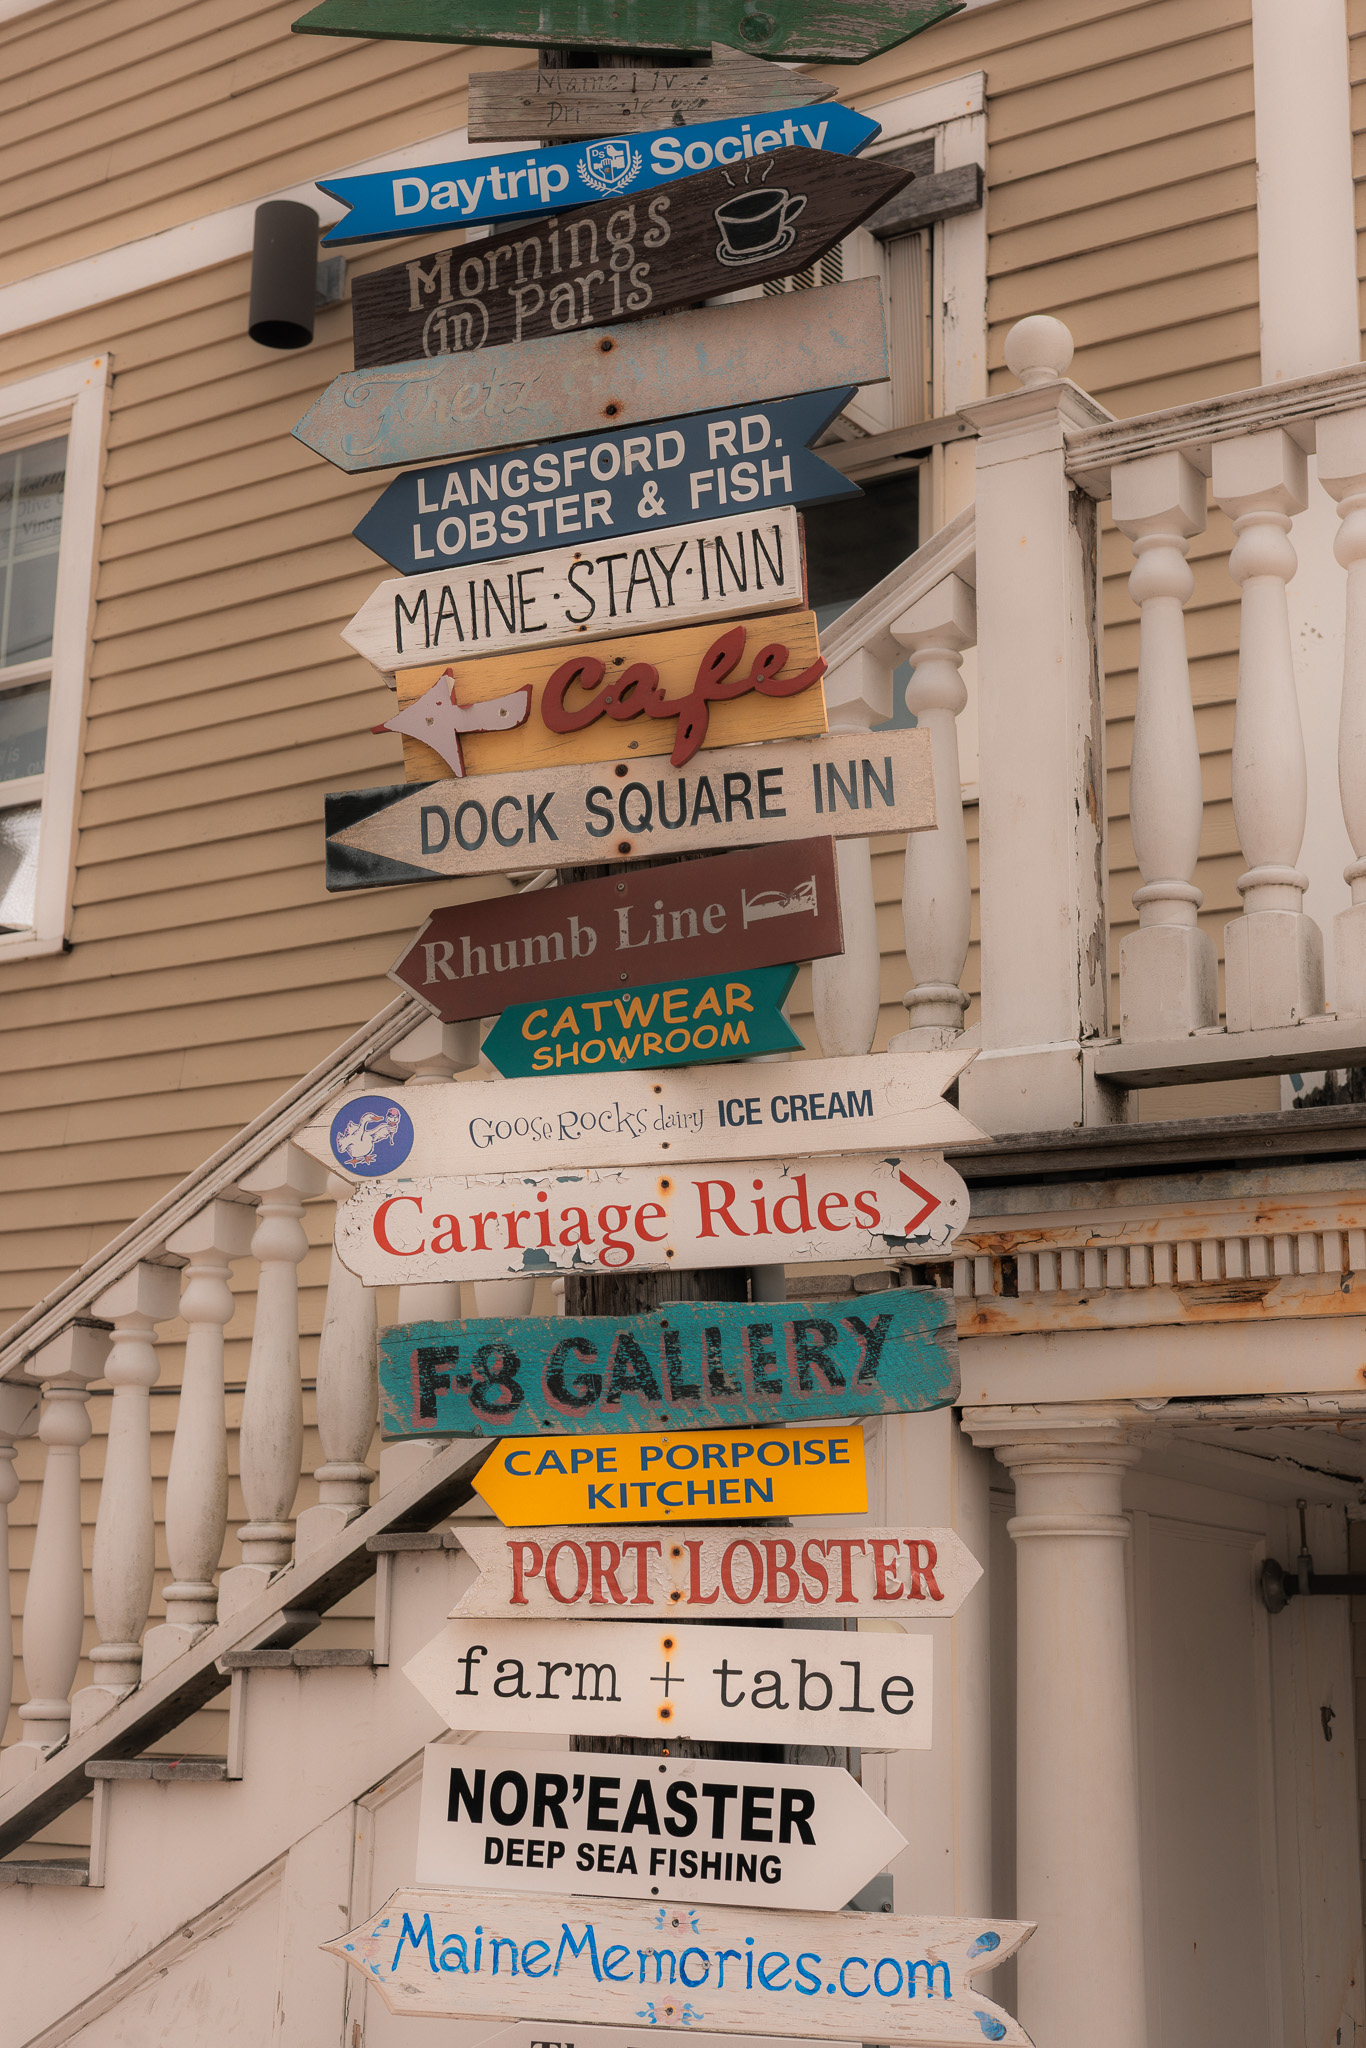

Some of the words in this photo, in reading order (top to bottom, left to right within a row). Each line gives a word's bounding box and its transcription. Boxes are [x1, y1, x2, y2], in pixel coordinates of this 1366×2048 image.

[392, 158, 569, 217] Daytrip
[651, 119, 828, 175] Society
[406, 196, 671, 312] Mornings
[508, 262, 653, 343] Paris
[417, 429, 686, 513] LANGSFORD
[708, 414, 783, 459] RD.
[413, 489, 614, 559] LOBSTER
[636, 479, 667, 519] &
[689, 454, 793, 508] FISH
[541, 625, 828, 768] Cafe
[421, 793, 559, 855] DOCK
[585, 767, 787, 838] SQUARE
[812, 756, 895, 814] INN
[421, 916, 597, 986] Rhumb
[613, 895, 728, 952] Line
[521, 982, 755, 1042] CATWEAR
[531, 1021, 751, 1070] SHOWROOM
[653, 1104, 705, 1133] dairy
[718, 1097, 762, 1128] ICE
[770, 1090, 874, 1123] CREAM
[372, 1191, 668, 1268] Carriage
[691, 1172, 882, 1239] Rides
[543, 1314, 894, 1417] GALLERY
[503, 1446, 617, 1477] CAPE
[640, 1438, 850, 1471] PORPOISE
[588, 1477, 774, 1509] KITCHEN
[507, 1539, 663, 1605] PORT
[684, 1538, 946, 1605] LOBSTER
[455, 1646, 622, 1702] farm
[649, 1660, 685, 1698] +
[712, 1658, 915, 1715] table
[447, 1767, 817, 1846] NOR'EASTER
[484, 1836, 565, 1868] DEEP
[577, 1842, 638, 1875] SEA
[649, 1847, 782, 1885] FISHING
[390, 1912, 953, 1999] MaineMemories.com
